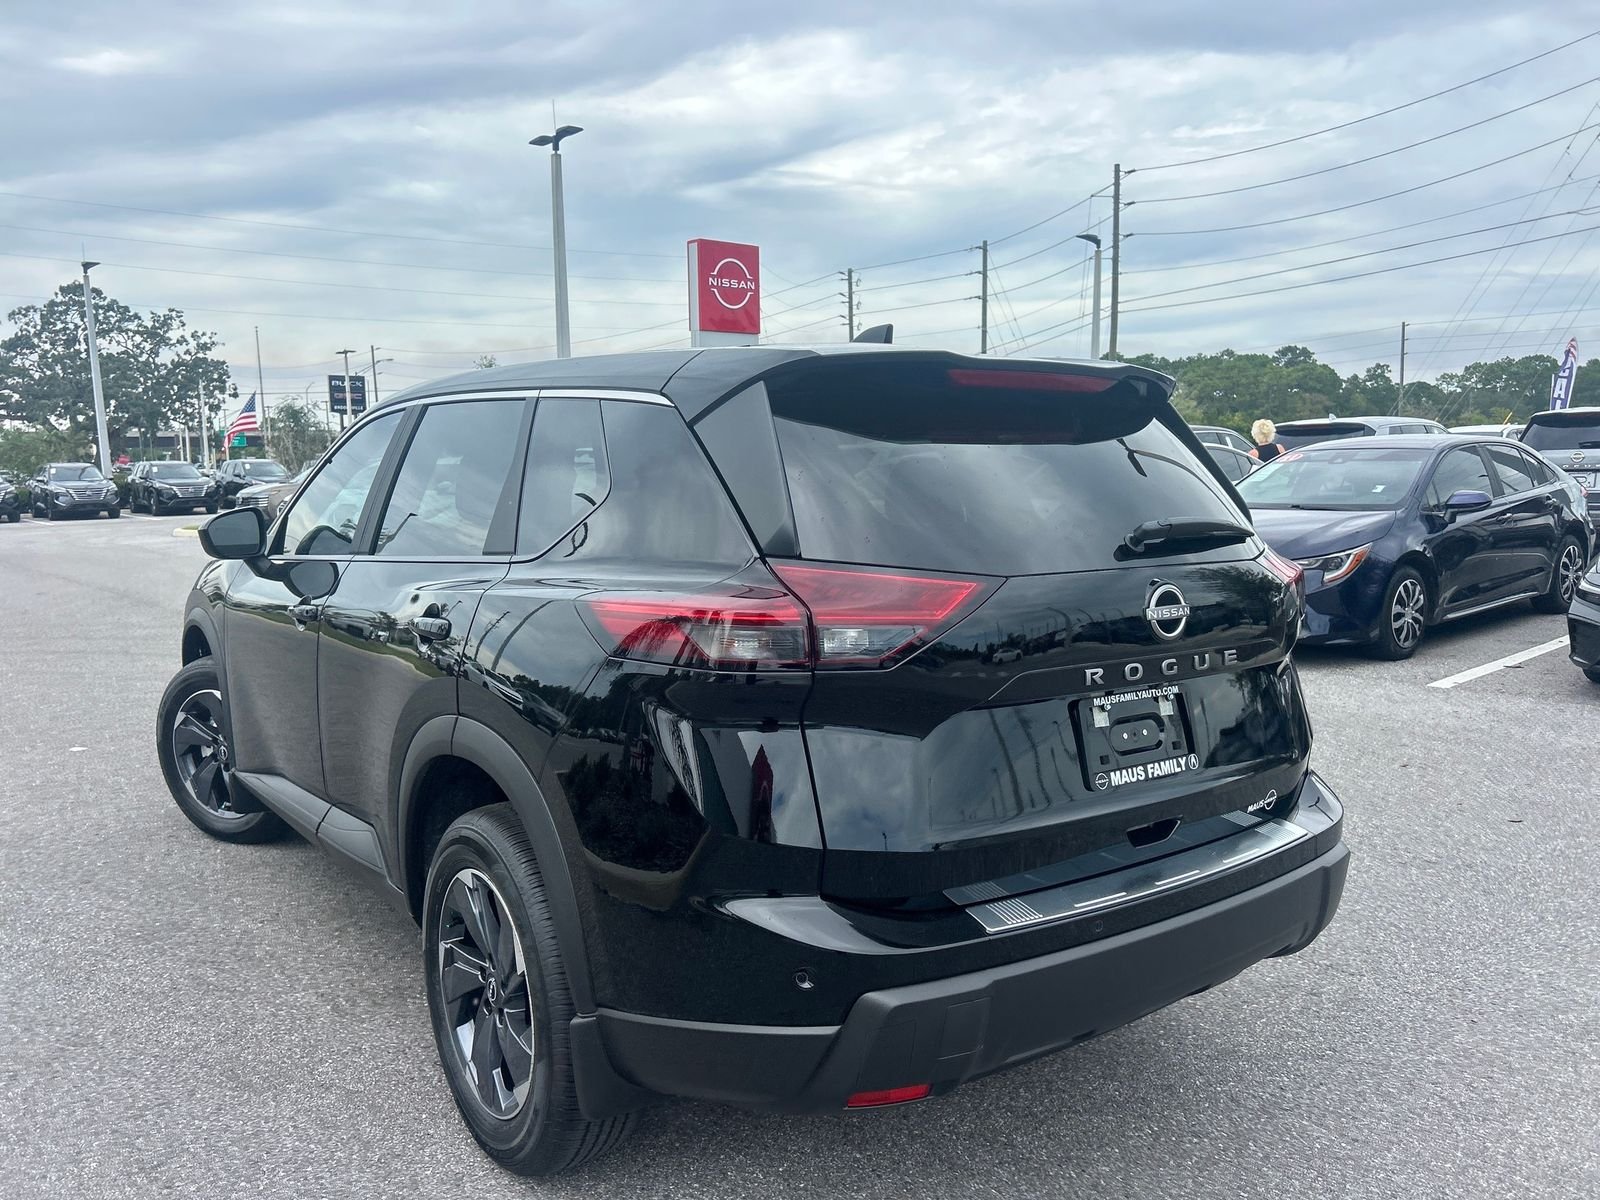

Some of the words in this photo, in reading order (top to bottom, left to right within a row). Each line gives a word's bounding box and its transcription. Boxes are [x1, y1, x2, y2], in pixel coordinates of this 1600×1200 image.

[708, 277, 755, 290] NISSAN
[1148, 606, 1190, 619] NISSAN
[1084, 649, 1239, 686] ROGUE
[1093, 685, 1179, 707] MAUSFAMILYAUTO.COM
[1110, 766, 1146, 787] MAUS
[1147, 756, 1187, 779] FAMILY
